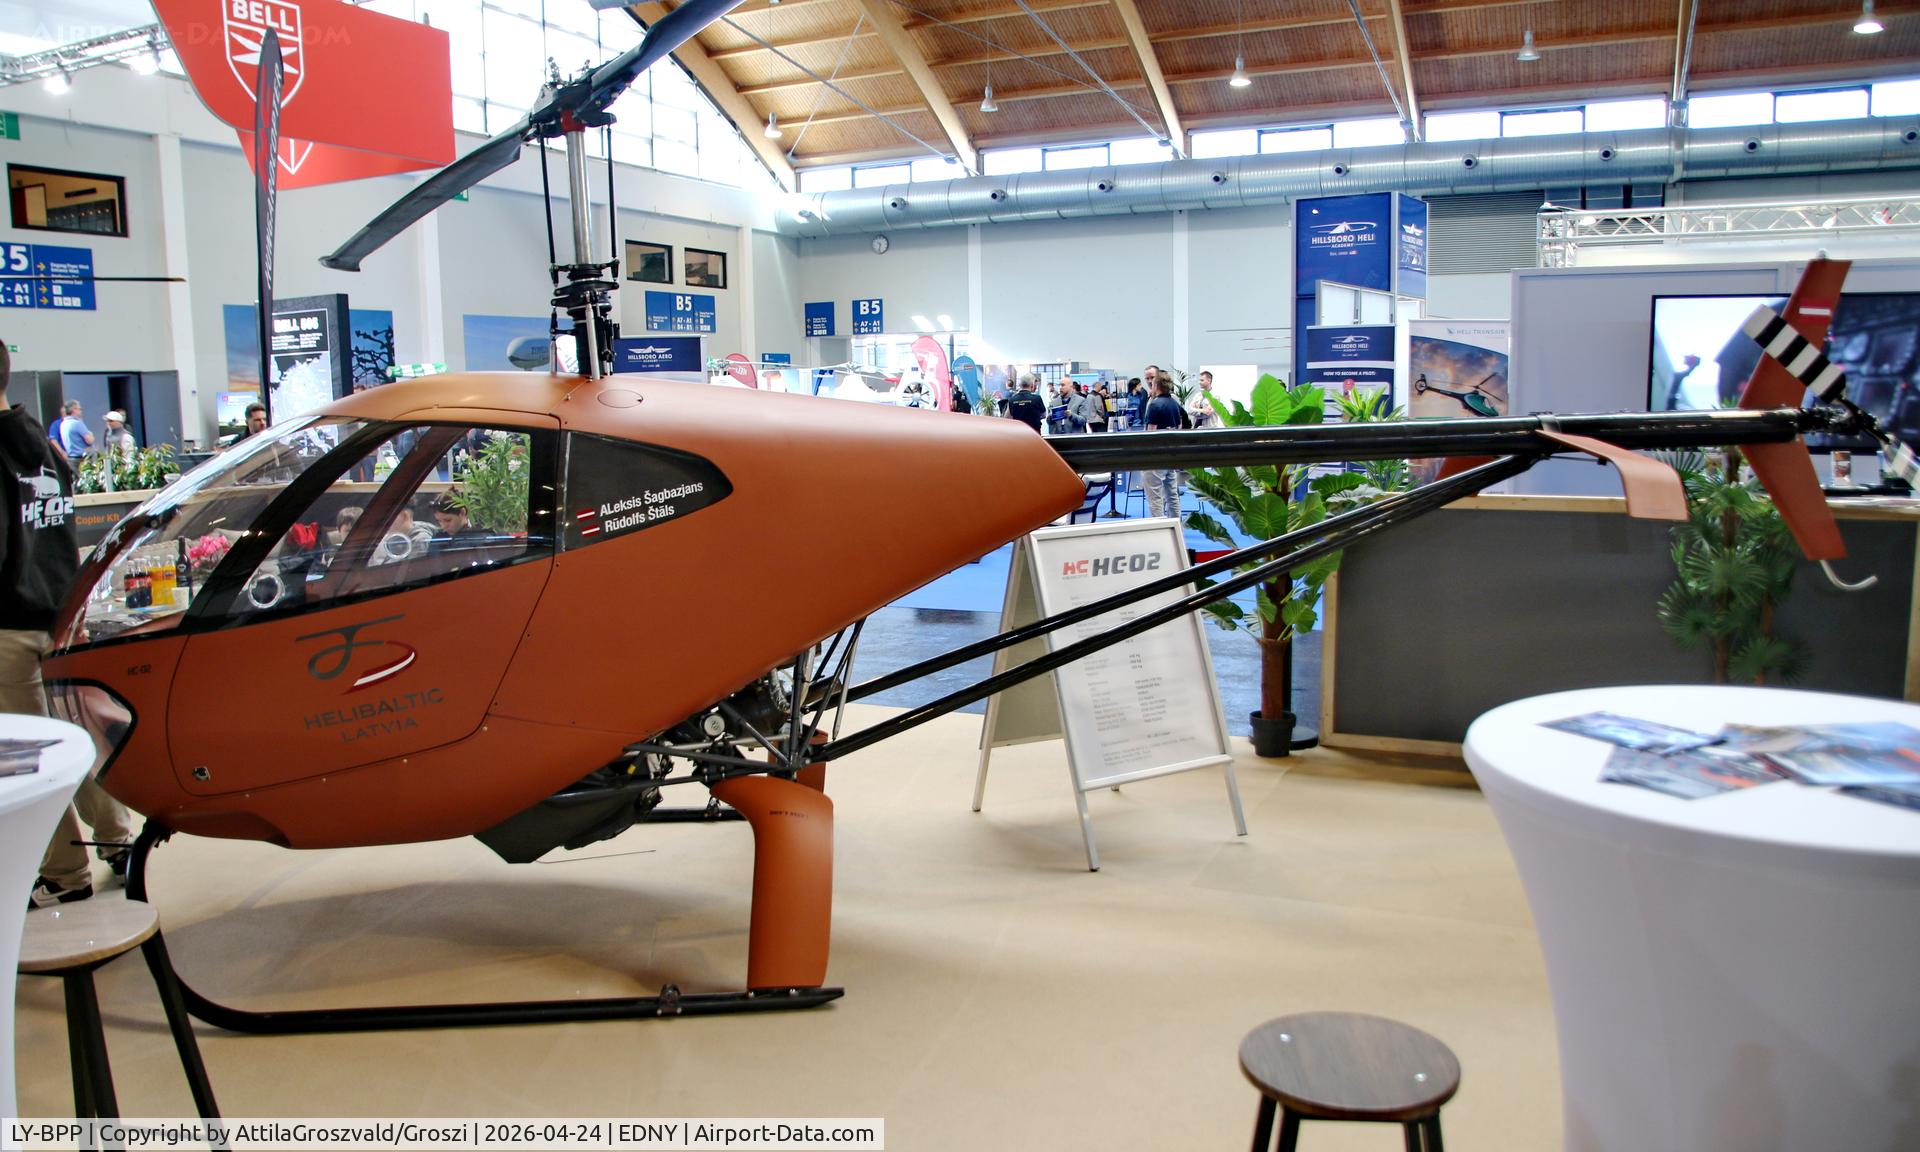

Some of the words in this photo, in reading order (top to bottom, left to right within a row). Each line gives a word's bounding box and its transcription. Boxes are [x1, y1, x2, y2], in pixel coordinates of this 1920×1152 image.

[232, 0, 295, 32] BELL
[1311, 235, 1355, 245] HILLSBORO
[1357, 233, 1374, 242] HELI
[14, 283, 29, 294] A1
[15, 294, 30, 305] B1
[675, 295, 692, 311] B5
[859, 300, 880, 315] B5
[273, 318, 300, 333] BELL
[600, 496, 642, 517] ALeksis
[643, 482, 704, 506] Šagbazjans
[605, 511, 646, 533] Rūdolfs
[648, 505, 675, 520] Štāls
[1062, 560, 1090, 576] HC
[1092, 552, 1161, 577] HC-02
[303, 687, 446, 731] HELIBALTIC
[342, 715, 419, 744] LATVIA
